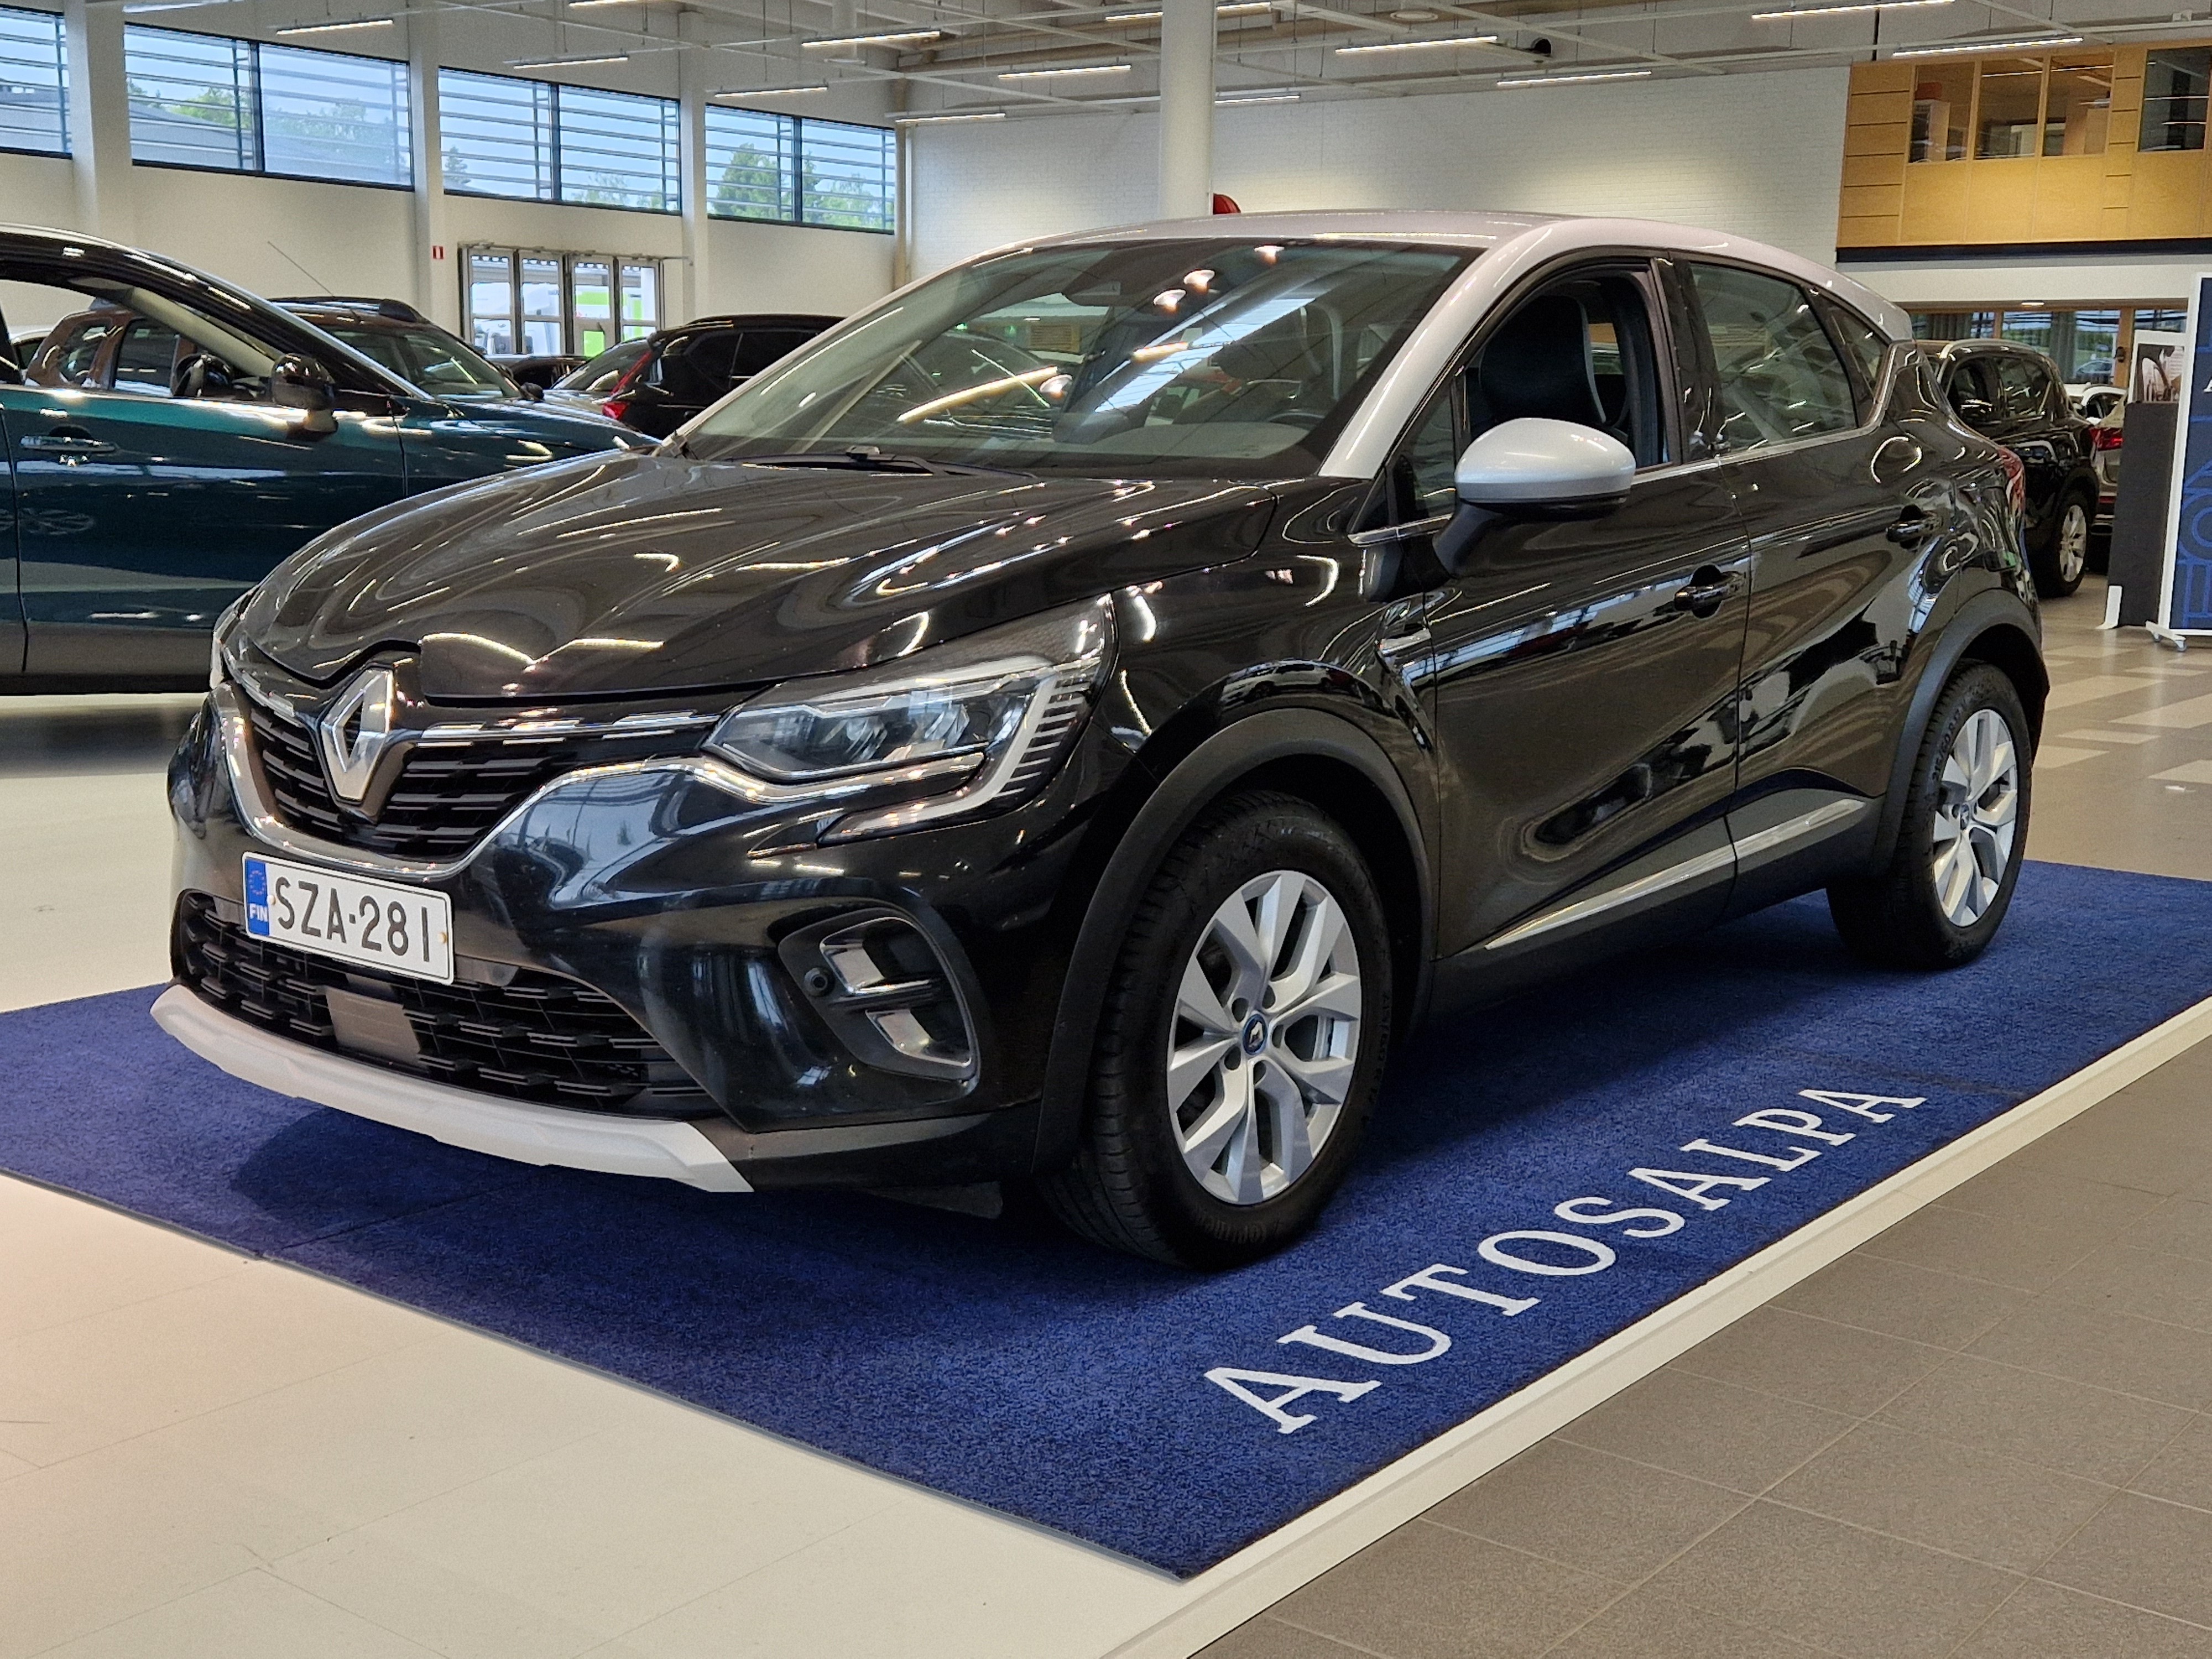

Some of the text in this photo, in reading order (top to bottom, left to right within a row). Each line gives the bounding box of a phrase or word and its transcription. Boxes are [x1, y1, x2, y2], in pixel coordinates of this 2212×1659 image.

[249, 902, 269, 923] FIN
[275, 877, 430, 962] SZA-281
[1203, 1087, 1928, 1434] AUTOSALPA
